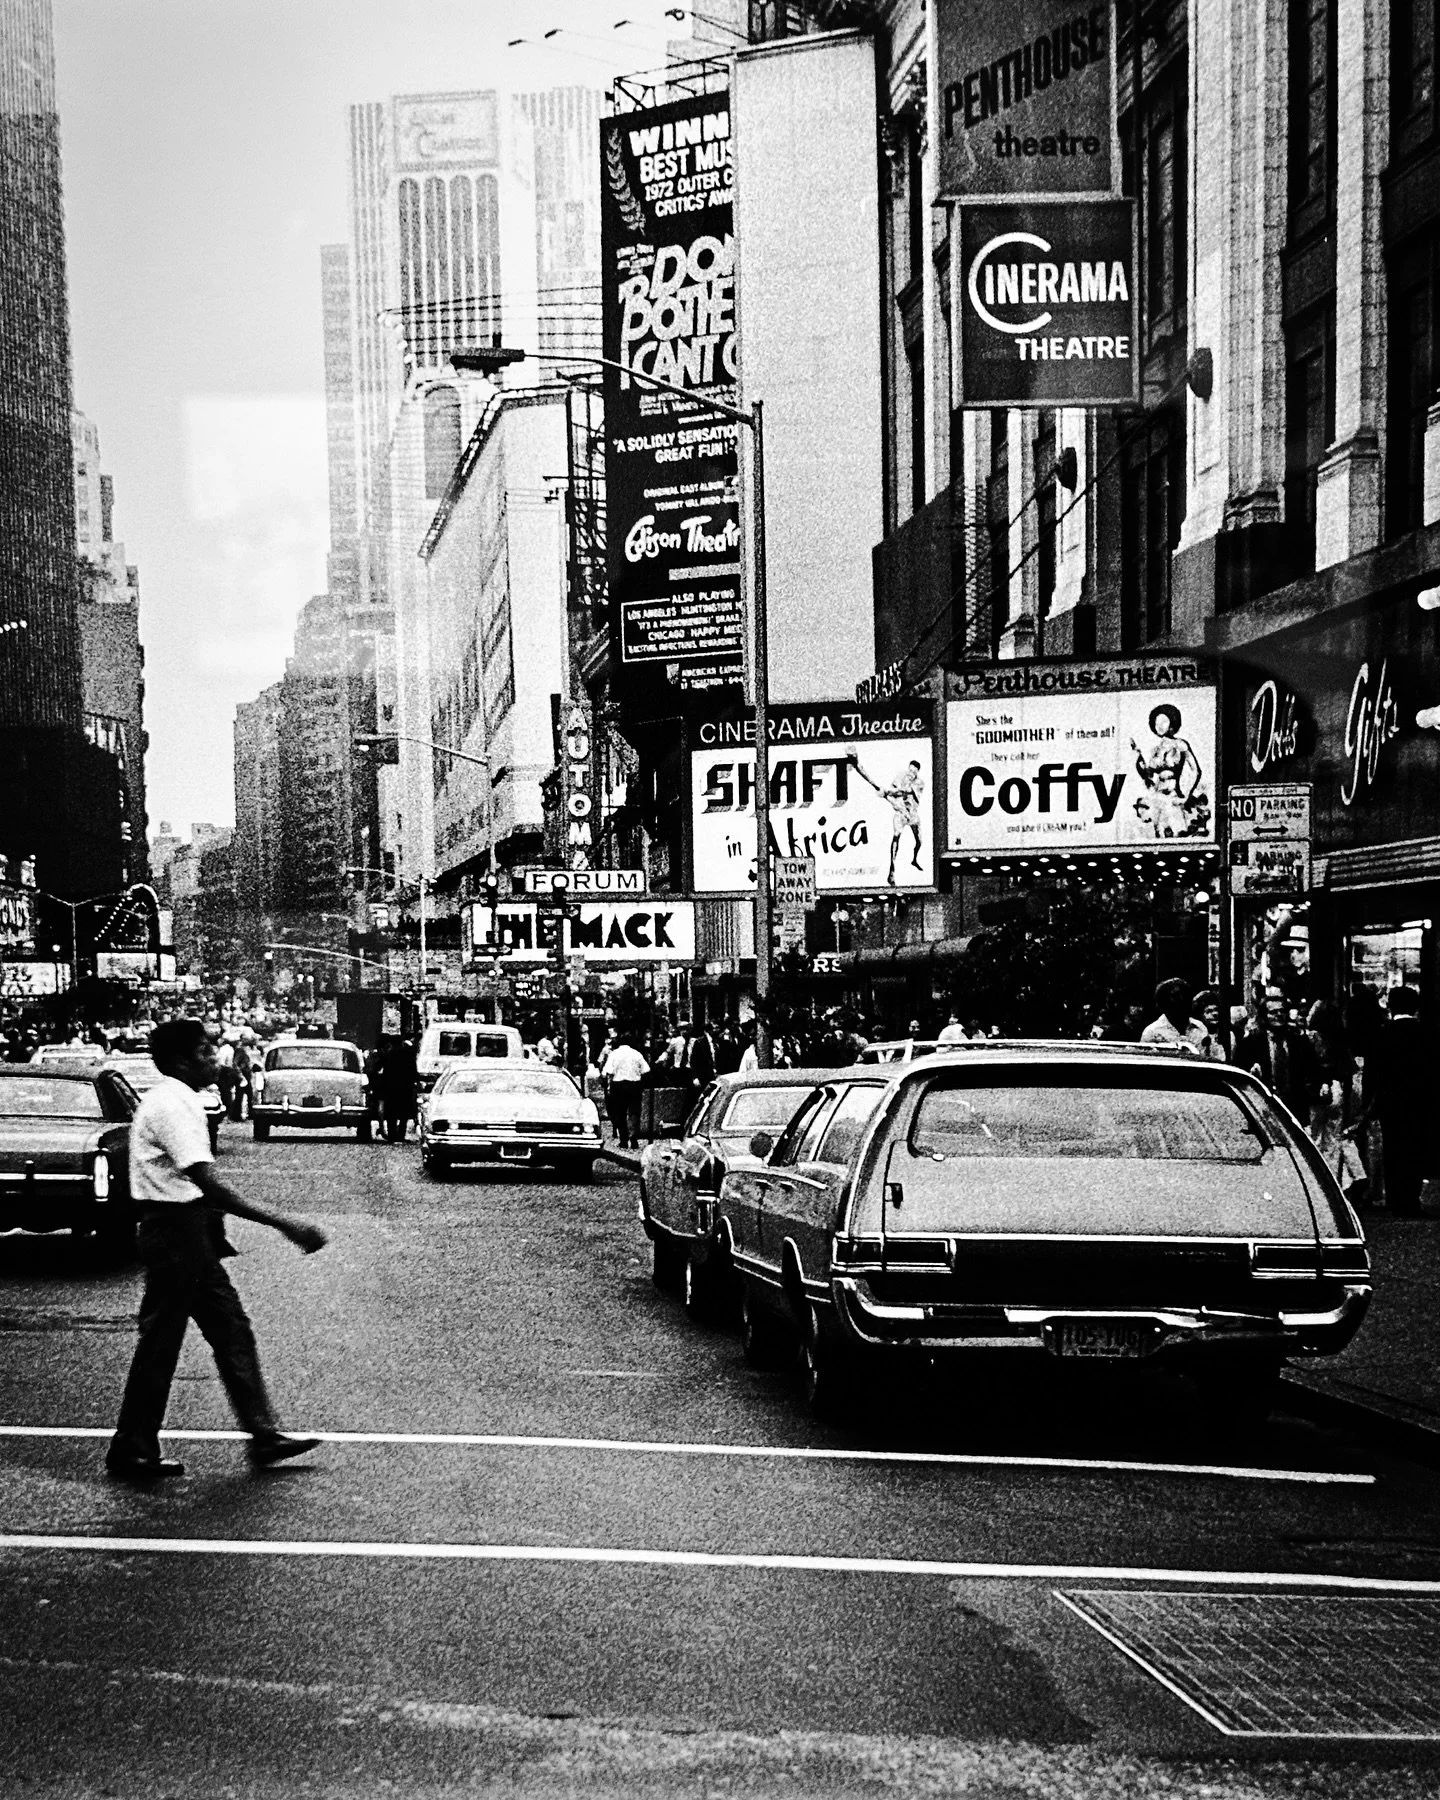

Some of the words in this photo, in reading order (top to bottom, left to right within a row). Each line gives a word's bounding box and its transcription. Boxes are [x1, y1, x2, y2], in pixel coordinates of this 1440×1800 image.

[944, 12, 1106, 138] PENTHOUSE
[994, 125, 1100, 158] theatre
[639, 148, 690, 184] BEST
[645, 180, 674, 202] 1972
[678, 170, 720, 194] OUTER
[654, 191, 708, 217] CRITICS'
[967, 231, 1129, 334] CINERAMA
[1016, 336, 1130, 361] THEATRE
[627, 432, 675, 452] SOLIDLY
[655, 445, 695, 463] GREAT
[624, 514, 681, 563] Edison
[671, 593, 694, 604] ALSO
[953, 665, 1108, 694] Penthouse
[700, 715, 835, 744] CINERAMA
[841, 713, 926, 737] Theatre
[1000, 714, 1013, 725] the
[1065, 729, 1074, 740] of
[1077, 729, 1098, 739] them
[701, 756, 854, 814] SHAFT
[959, 761, 1127, 824] Coffy
[1231, 799, 1254, 817] NO
[1260, 798, 1306, 810] PARKING
[726, 835, 742, 858] in
[782, 863, 807, 874] TOW
[532, 872, 638, 891] FORUM
[777, 877, 812, 888] AWAY
[778, 891, 813, 903] ZONE
[570, 911, 676, 949] MACK
